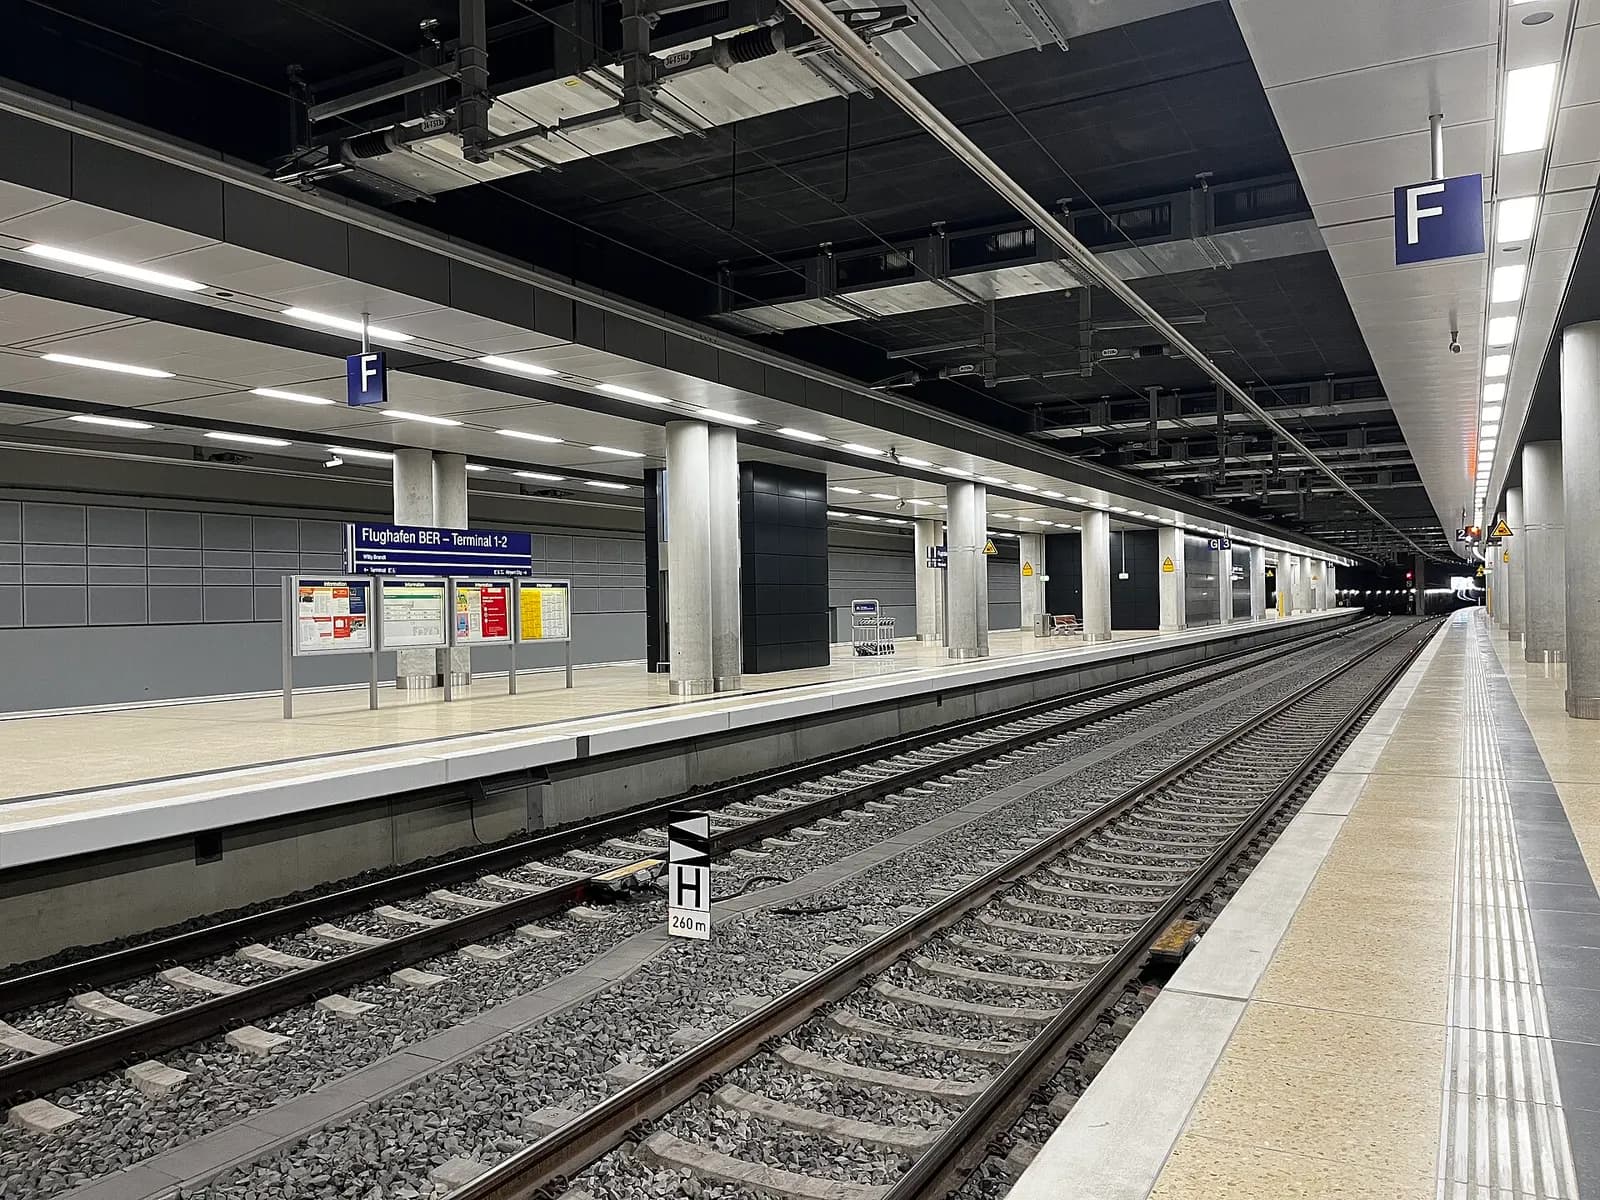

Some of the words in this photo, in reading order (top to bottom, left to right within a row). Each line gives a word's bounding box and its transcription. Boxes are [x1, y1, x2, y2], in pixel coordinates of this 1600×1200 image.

[1407, 183, 1445, 245] F
[361, 354, 378, 393] F
[362, 527, 416, 544] Flughafen
[418, 532, 441, 545] BER
[451, 533, 492, 547] Terminal
[493, 535, 508, 548] 1-2
[1210, 539, 1218, 549] G
[1223, 538, 1230, 548] 3
[1457, 530, 1466, 539] 2
[677, 866, 701, 908] H
[672, 915, 693, 930] 260
[695, 921, 706, 932] m
